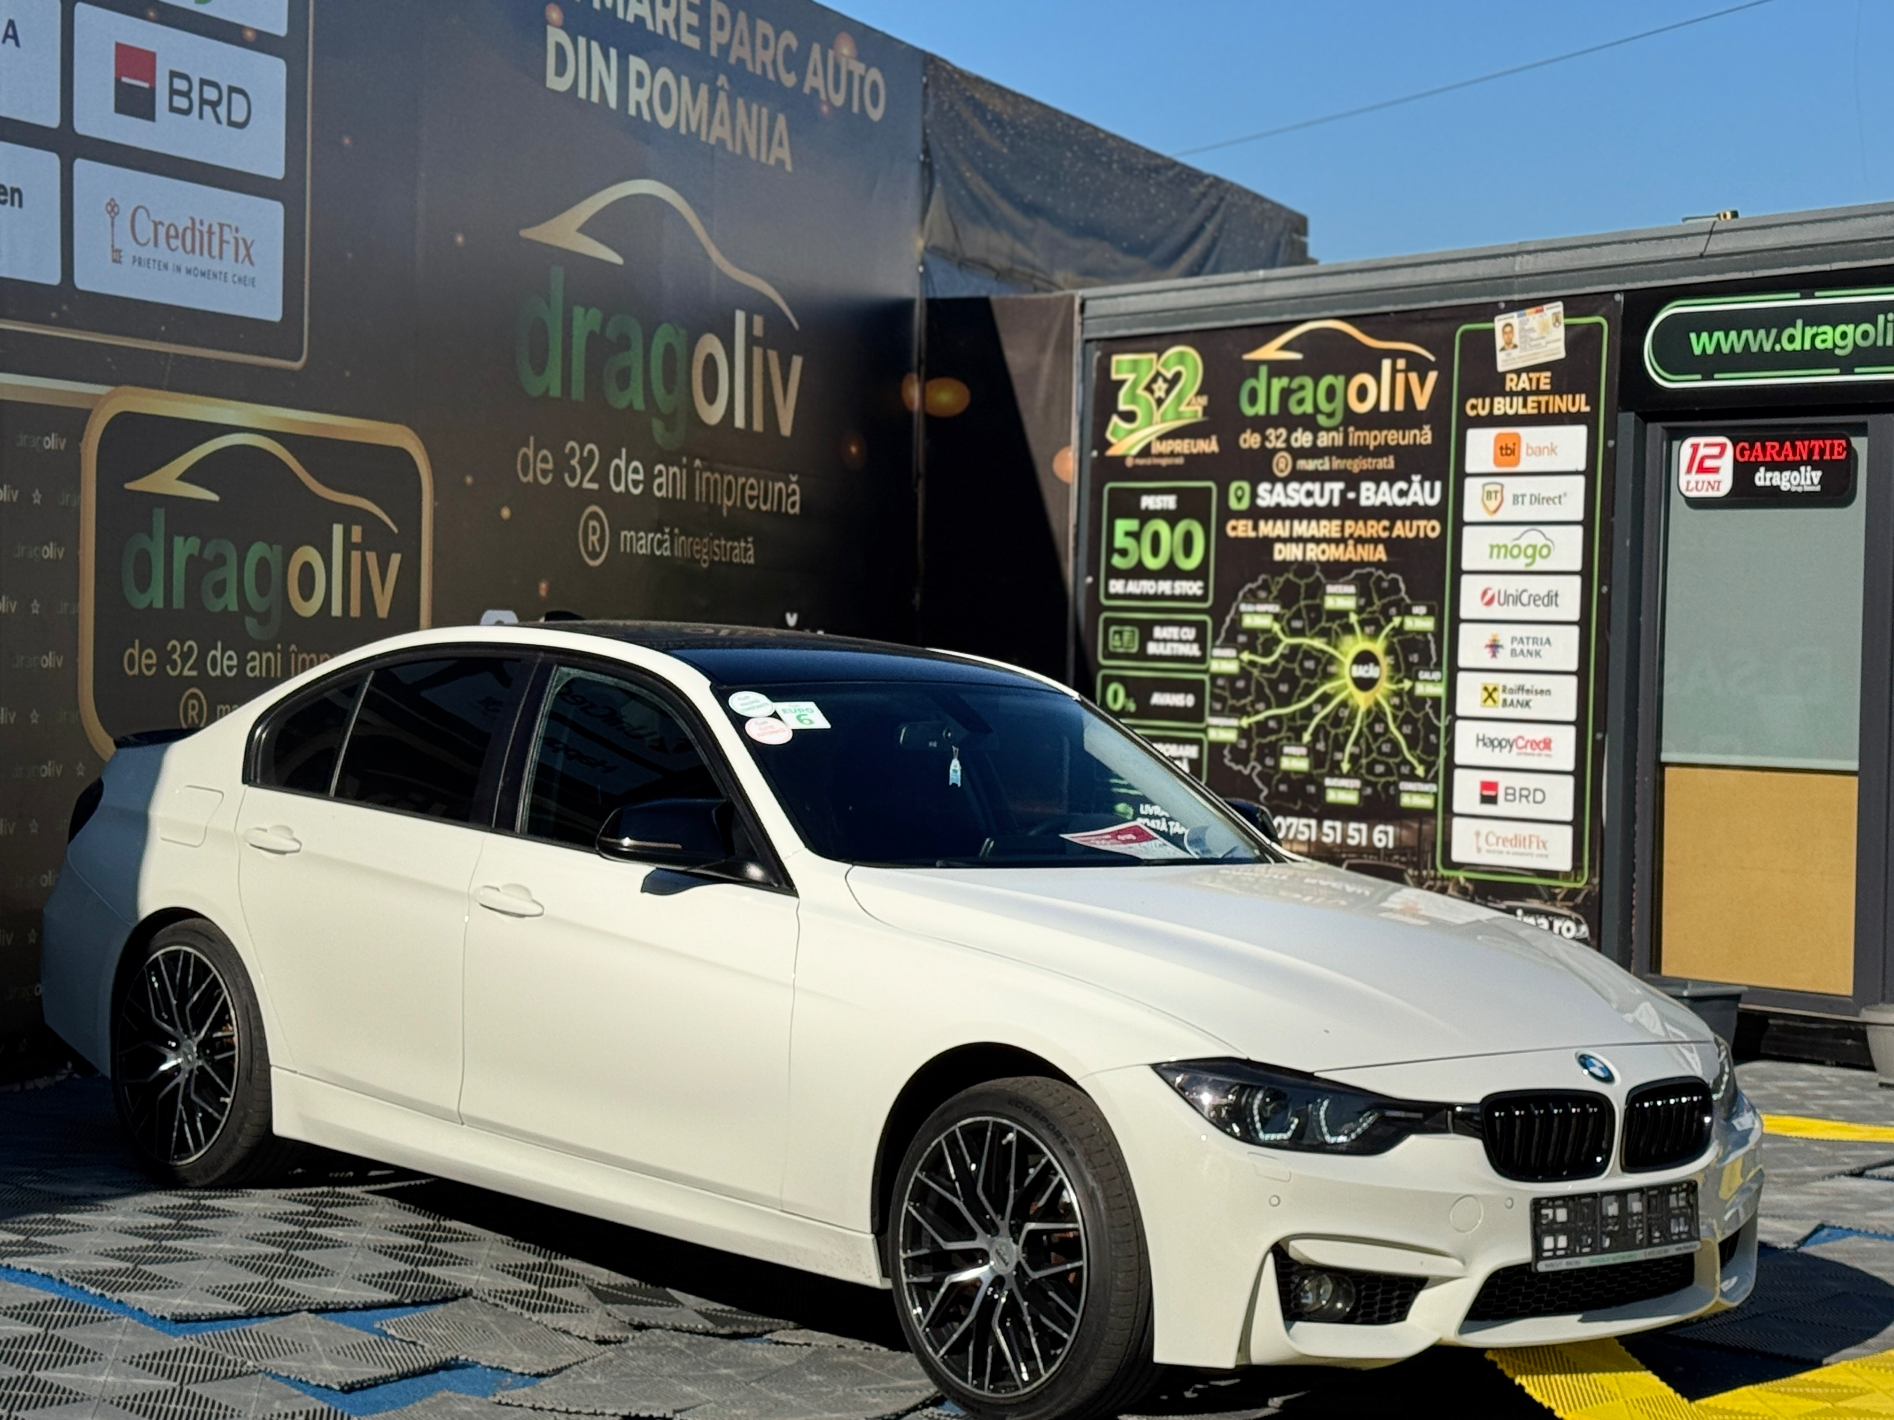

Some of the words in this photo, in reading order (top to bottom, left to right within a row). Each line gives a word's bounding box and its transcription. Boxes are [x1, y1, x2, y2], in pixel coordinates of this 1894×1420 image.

[709, 1, 799, 88] PARC
[803, 43, 887, 122] AUTO
[168, 69, 252, 130] BRD
[546, 25, 618, 110] DIN
[628, 74, 793, 173] ROMÂNIA
[130, 204, 255, 267] CreditFix
[132, 255, 169, 272] PRIETEN
[172, 262, 182, 274] IN
[185, 265, 229, 284] MOMENTE
[231, 273, 256, 288] CHEIE
[1689, 312, 1894, 356] www.dragoli
[515, 264, 803, 453] dragoliv
[1239, 358, 1439, 427] dragoliv
[1505, 372, 1552, 391] RATE
[1465, 398, 1490, 416] CU
[1493, 394, 1591, 416] BULETINUL
[1239, 429, 1262, 449] de
[1265, 427, 1287, 448] 32
[1290, 427, 1312, 448] de
[1317, 426, 1344, 446] ani
[1348, 425, 1433, 450] împreună
[1498, 442, 1517, 458] tbi
[1526, 442, 1558, 457] bank
[1685, 442, 1728, 475] 12
[1735, 439, 1848, 462] GARANTIE
[1296, 455, 1330, 471] marcă
[1332, 455, 1395, 474] înregistrată
[516, 436, 554, 485] de
[564, 440, 600, 490] 32
[609, 447, 645, 495] de
[653, 456, 687, 501] ani
[695, 457, 801, 518] împreună
[1685, 480, 1722, 493] LUNI
[1754, 466, 1823, 491] dragoliv
[1255, 482, 1345, 508] SASCUT
[1359, 474, 1442, 507] BACĂU
[1486, 491, 1500, 502] BT
[1512, 493, 1527, 506] BT
[1140, 494, 1178, 511] PESTE
[1225, 519, 1261, 538] CEL
[1262, 520, 1290, 538] MAI
[1292, 519, 1342, 538] MARE
[1343, 519, 1390, 538] PARC
[1392, 519, 1441, 539] AUTO
[620, 526, 672, 557] marcă
[674, 527, 755, 567] înregistrată
[1110, 518, 1206, 571] 500
[1273, 543, 1303, 562] DIN
[1305, 540, 1388, 562] ROMÂNIA
[1488, 541, 1552, 568] mogo
[121, 507, 402, 641] dragoliv
[1108, 579, 1126, 594] DE
[1127, 580, 1156, 595] AUTO
[1156, 581, 1173, 595] PE
[1173, 581, 1204, 596] STOC
[1497, 588, 1560, 608] UniCredit
[1152, 626, 1178, 641] RATE
[1510, 635, 1552, 648] PATRIA
[124, 640, 157, 676] de
[166, 640, 199, 677] 32
[206, 640, 239, 677] de
[246, 643, 282, 677] ani
[1510, 648, 1542, 659] BANK
[1501, 684, 1552, 697] Raiffeisen
[781, 707, 815, 715] EURO
[1501, 697, 1532, 709] BANK
[795, 713, 815, 726] 6
[1475, 732, 1552, 754] HappyCredit
[1503, 787, 1546, 805] BRD
[1273, 815, 1318, 842] 0751
[1321, 820, 1342, 844] 51
[1346, 822, 1368, 847] 51
[1372, 825, 1395, 849] 61
[1485, 831, 1549, 851] CreditFix
